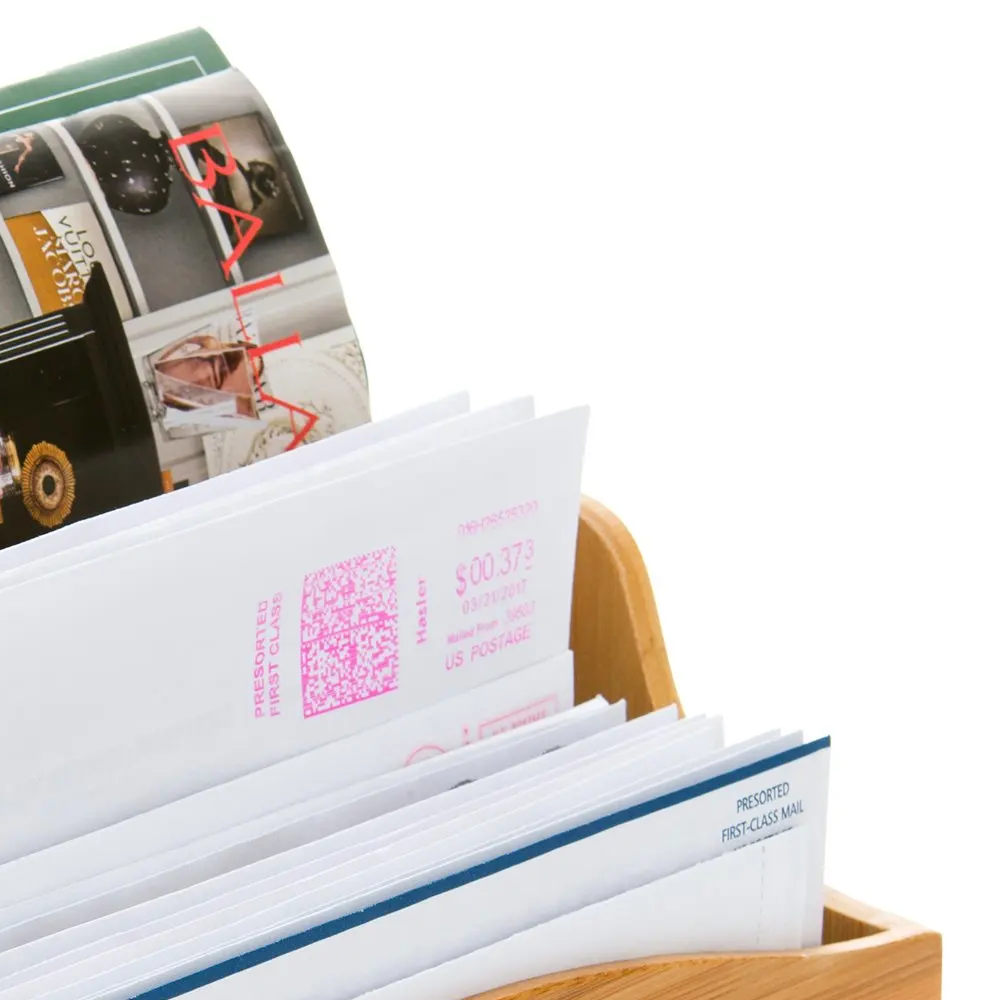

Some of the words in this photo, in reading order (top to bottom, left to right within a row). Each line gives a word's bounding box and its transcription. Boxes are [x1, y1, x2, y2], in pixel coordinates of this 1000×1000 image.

[269, 590, 284, 656] CLASS
[415, 577, 429, 646] Hasler
[253, 598, 269, 719] PRESORTED
[445, 649, 465, 672] US
[470, 623, 532, 662] POSTAGE
[268, 661, 281, 718] FIRST
[721, 808, 779, 843] FIRST-CLASS
[781, 799, 805, 821] MAIL
[736, 781, 790, 814] PRESORTED
